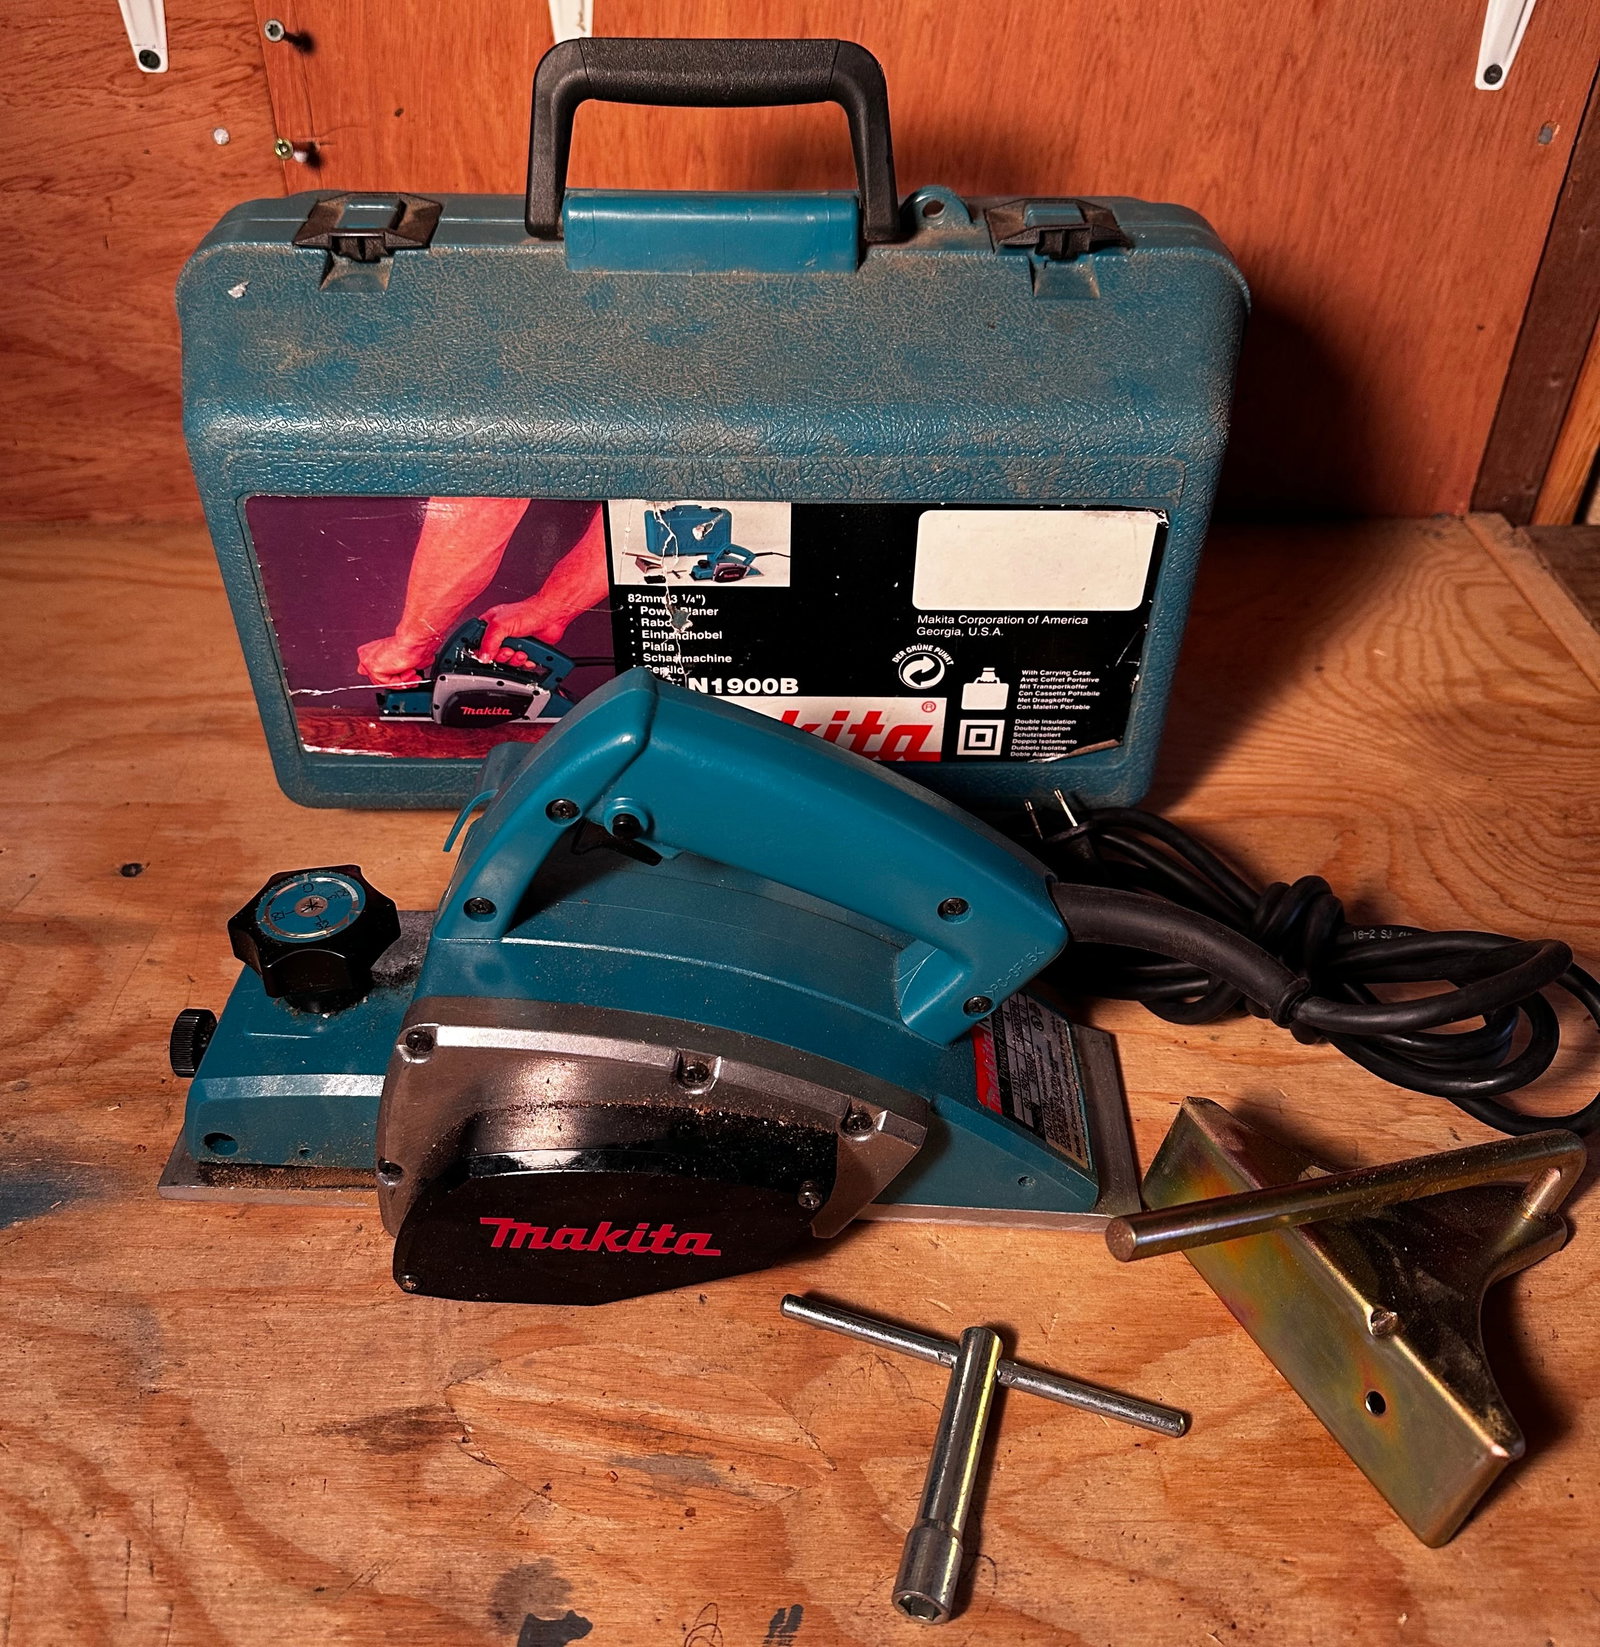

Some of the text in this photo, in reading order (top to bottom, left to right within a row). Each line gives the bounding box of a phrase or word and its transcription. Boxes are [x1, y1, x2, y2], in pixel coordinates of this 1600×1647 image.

[640, 605, 672, 616] Pow
[640, 617, 672, 627] Rabo
[917, 614, 1089, 627] Makita Corporation of America
[916, 626, 1004, 638] Georgia, U.S.A.
[642, 653, 732, 663] Schaamachine
[891, 650, 907, 663] DER
[933, 646, 955, 665] PUNKT
[1040, 669, 1071, 677] Carrying
[688, 677, 799, 694] N1900B
[480, 1217, 722, 1257] makita
